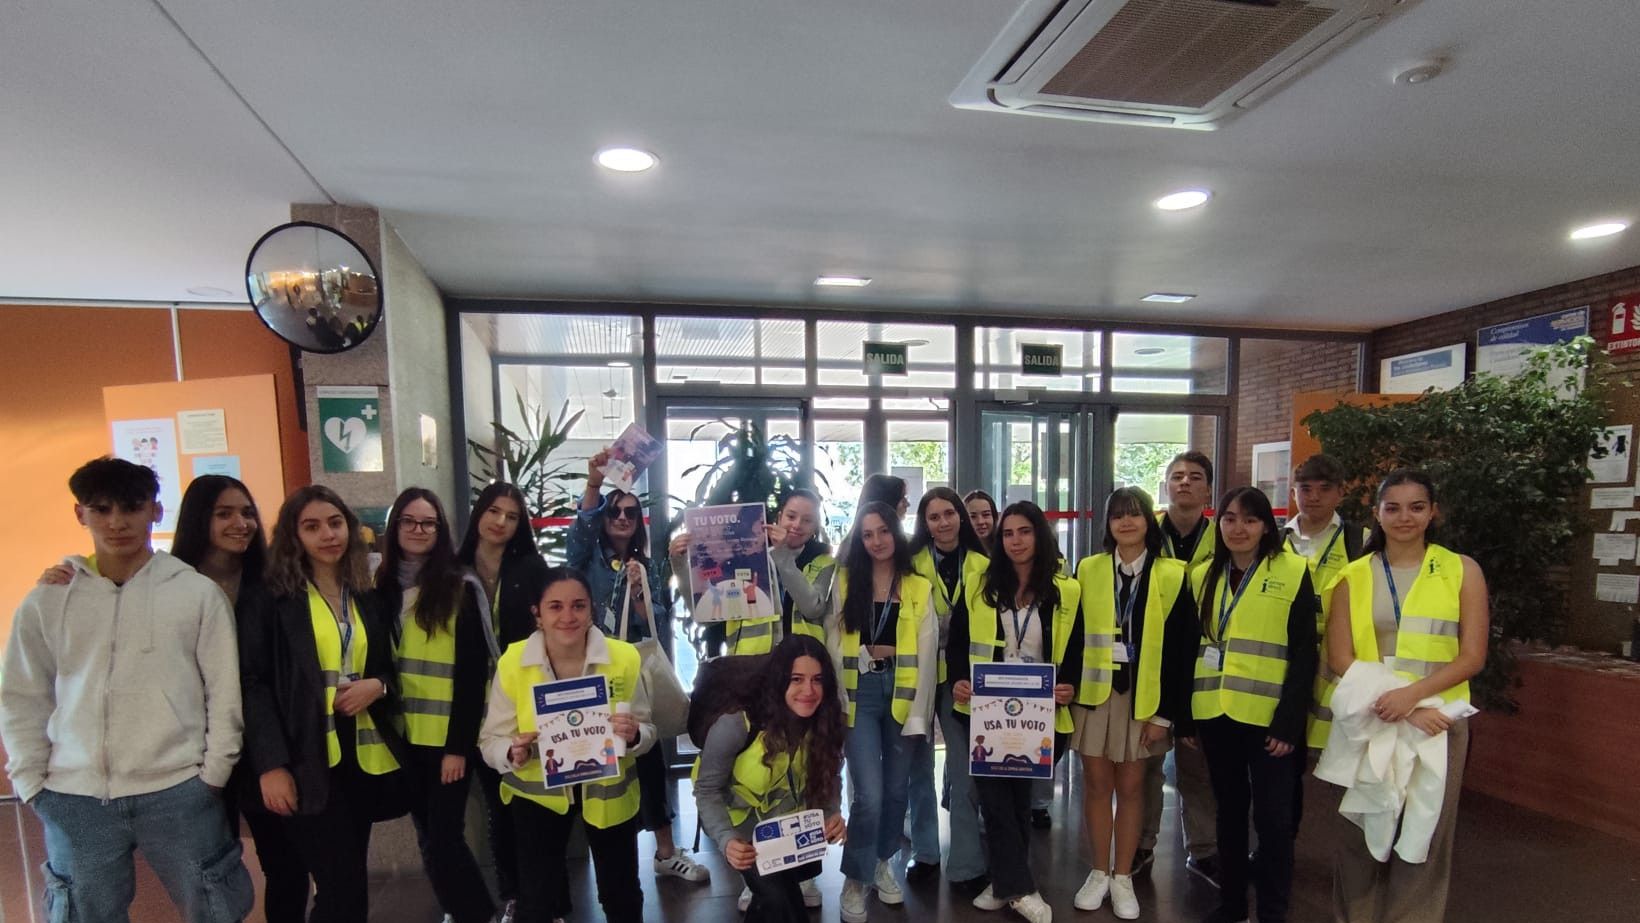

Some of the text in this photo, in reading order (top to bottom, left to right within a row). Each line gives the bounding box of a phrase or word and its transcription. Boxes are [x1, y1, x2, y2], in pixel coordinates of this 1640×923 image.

[866, 352, 905, 366] SALIDA
[1024, 353, 1060, 367] SALIDA
[694, 515, 740, 526] TU VOTO.
[984, 719, 1046, 732] USA TU VOTO
[551, 725, 606, 744] USA TU VOTO
